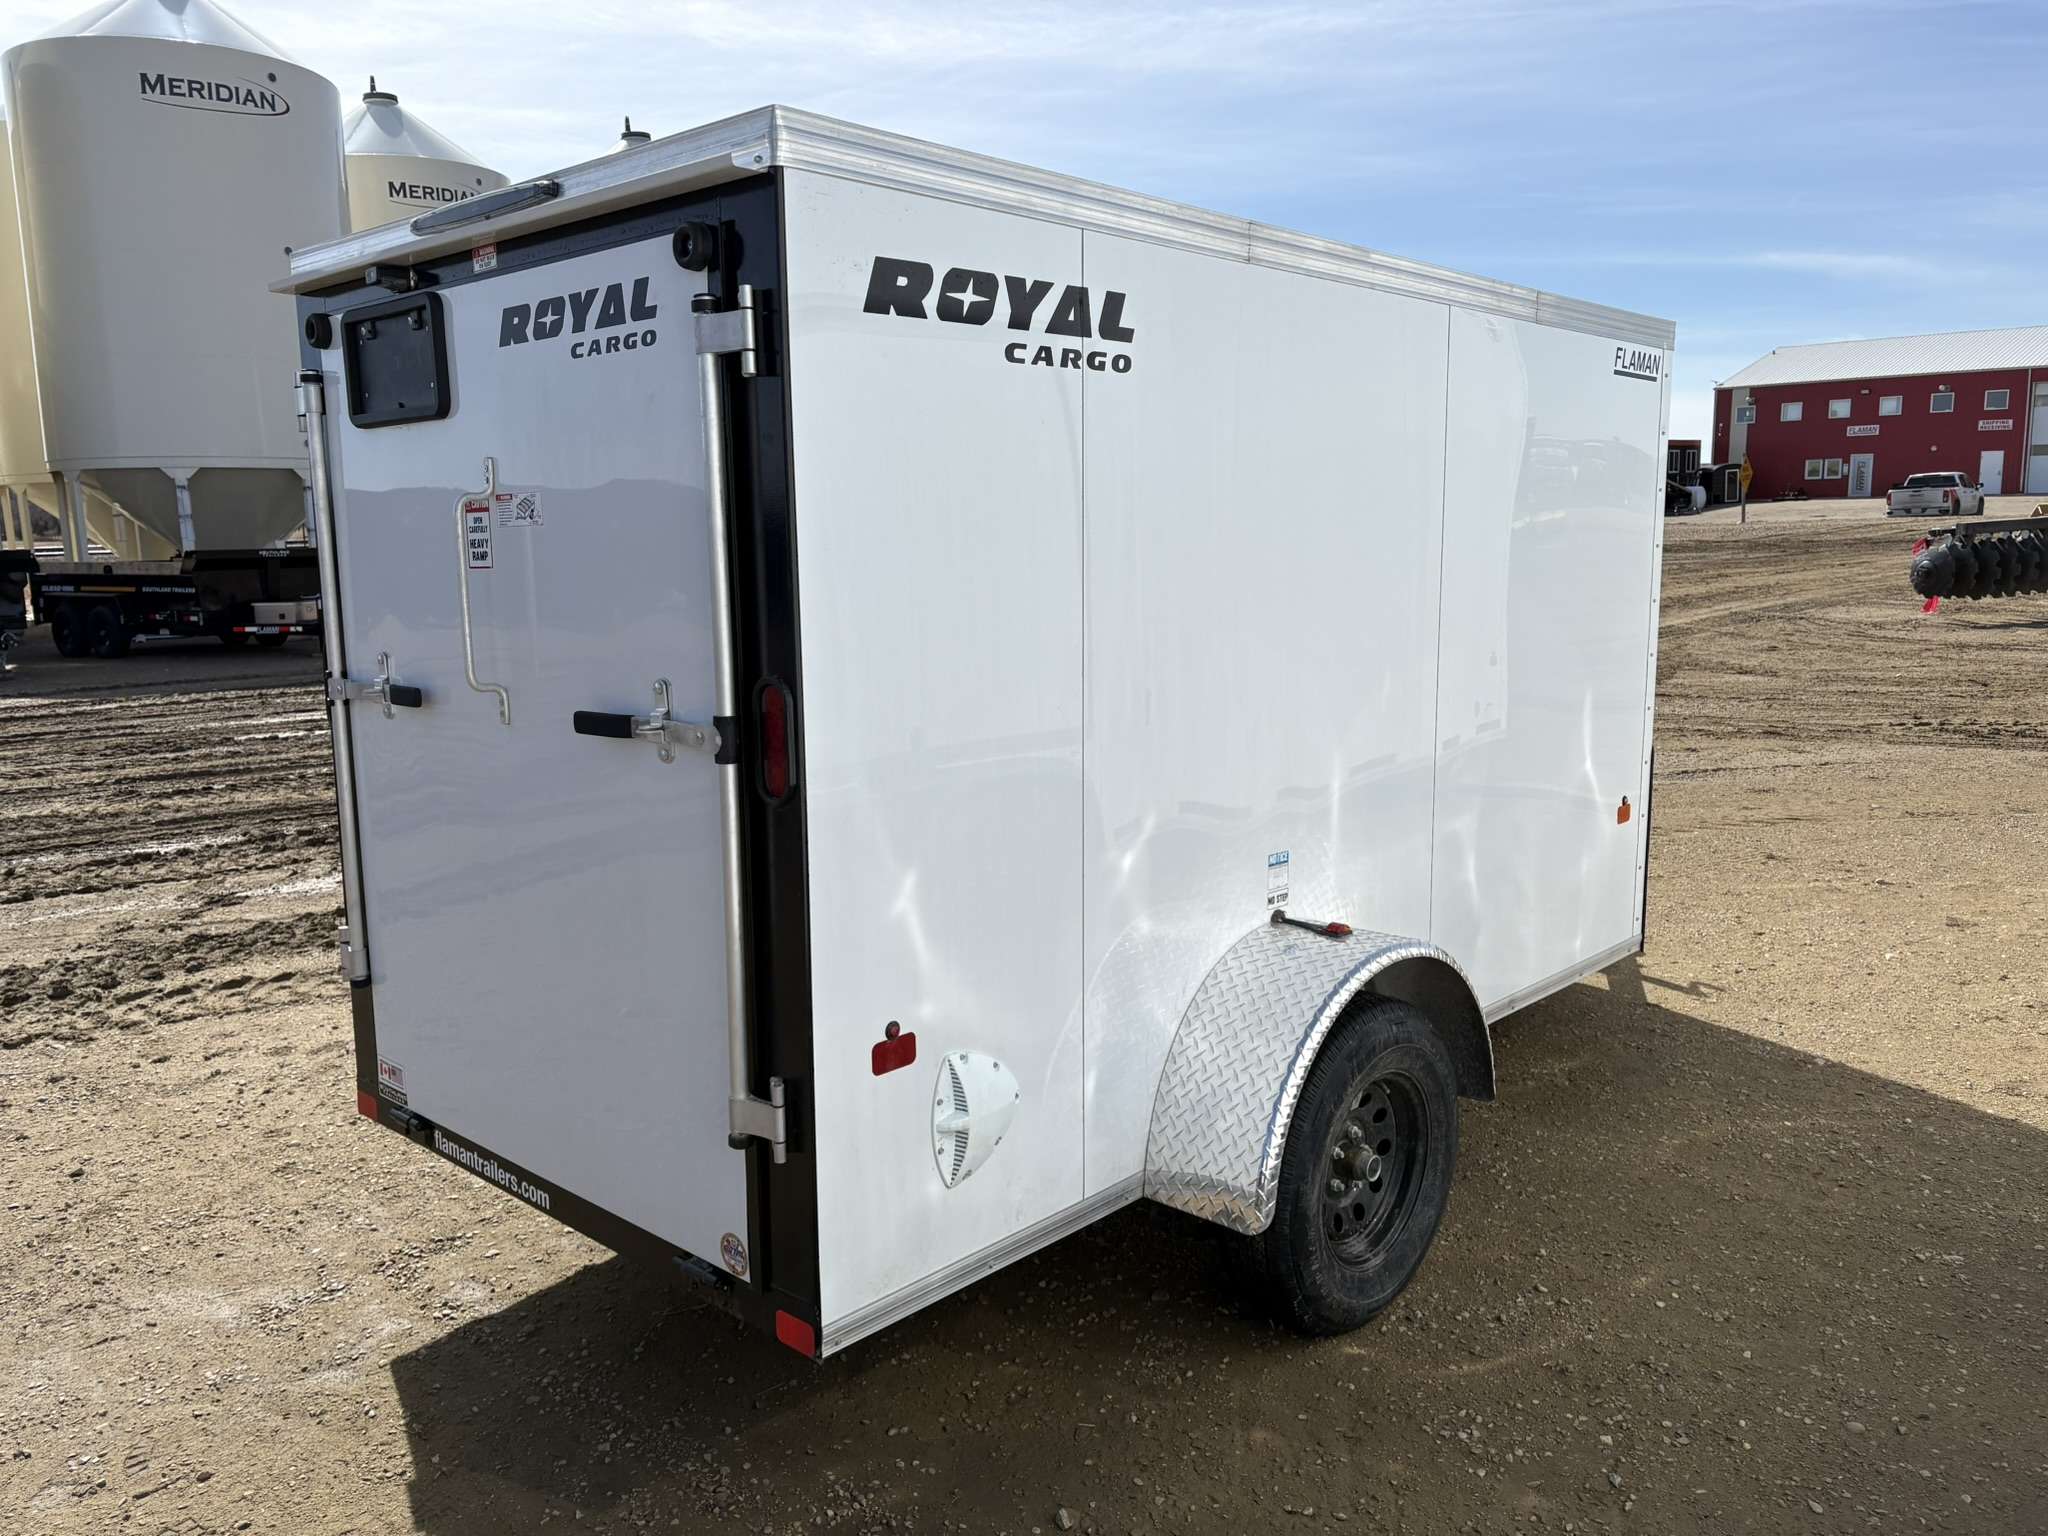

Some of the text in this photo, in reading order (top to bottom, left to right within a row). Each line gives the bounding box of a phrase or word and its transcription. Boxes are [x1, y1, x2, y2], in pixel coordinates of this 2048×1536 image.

[139, 72, 277, 113] MERIDIAN
[387, 180, 475, 202] MERIDIA
[498, 276, 658, 348] ROYAL
[863, 256, 1135, 343] ROYAL
[570, 329, 658, 359] CARGO
[1004, 342, 1133, 374] CARGO
[1614, 346, 1661, 375] FLAMAN
[469, 525, 488, 534] CAREFULLY
[473, 516, 483, 525] OPEN
[470, 538, 489, 549] HEAVY
[472, 551, 489, 561] RAMP
[1267, 892, 1288, 905] NO STEP
[434, 1130, 551, 1210] flamantrailers.com
